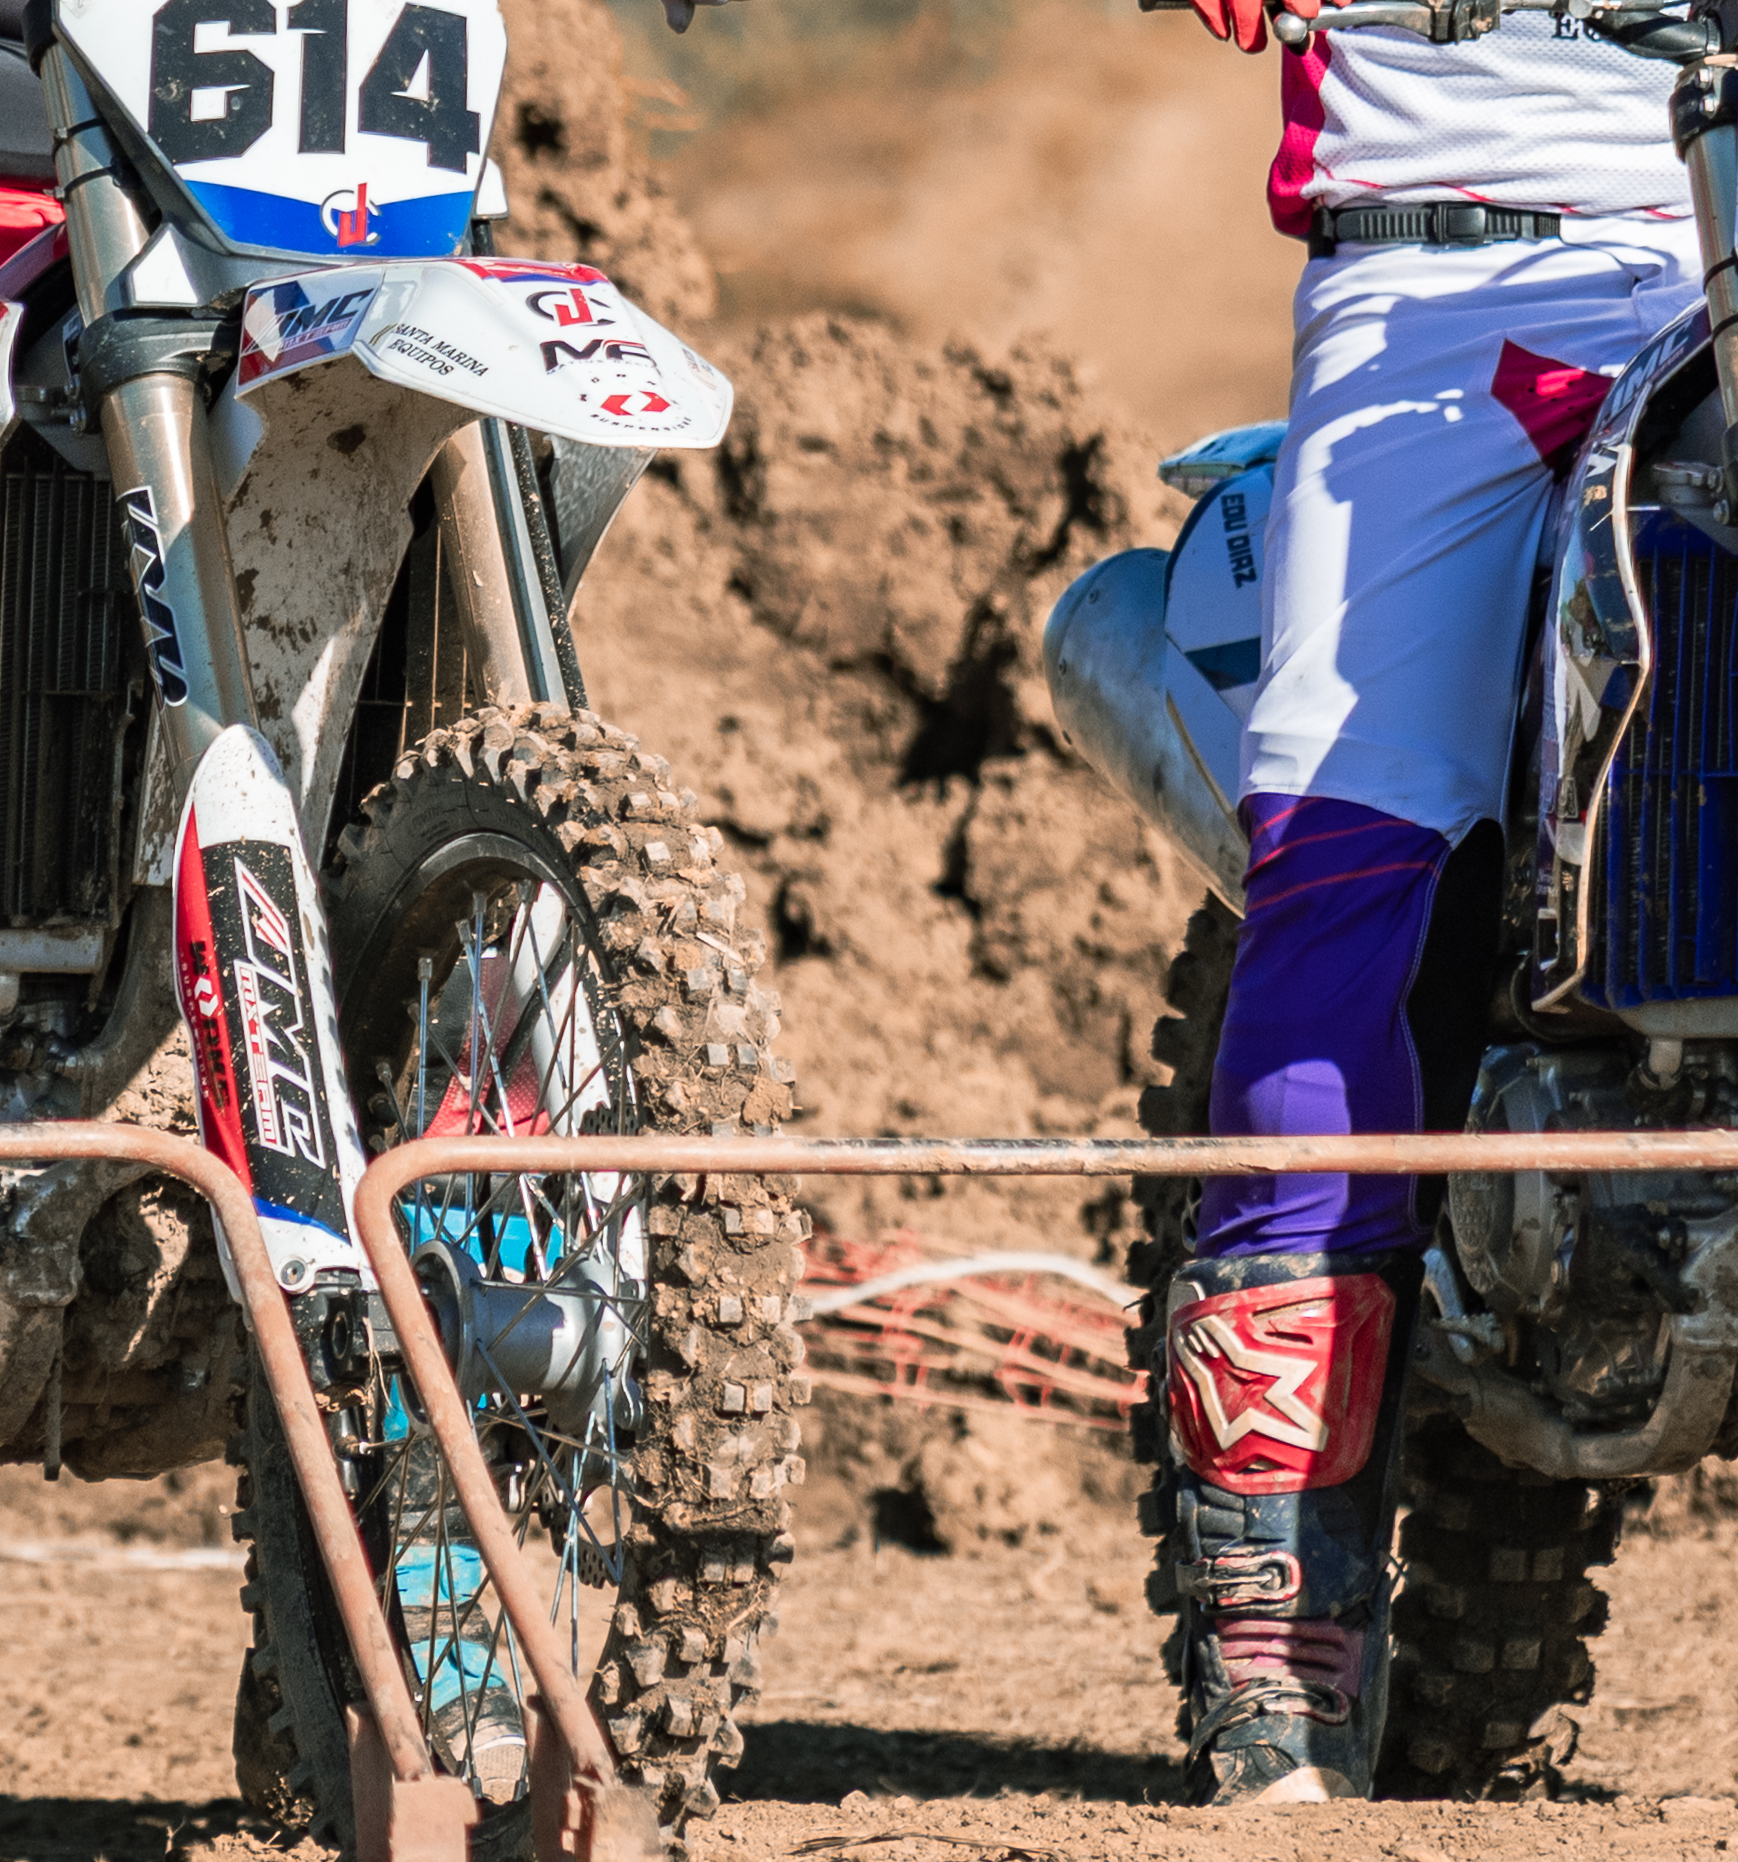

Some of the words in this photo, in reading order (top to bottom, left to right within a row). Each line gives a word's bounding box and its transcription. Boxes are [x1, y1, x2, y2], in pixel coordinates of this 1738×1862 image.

[388, 338, 455, 376] EQUIPOS
[392, 323, 434, 345] SANTA
[431, 340, 490, 377] MARINA
[1221, 492, 1247, 534] EDU
[1227, 534, 1257, 589] DIAZ
